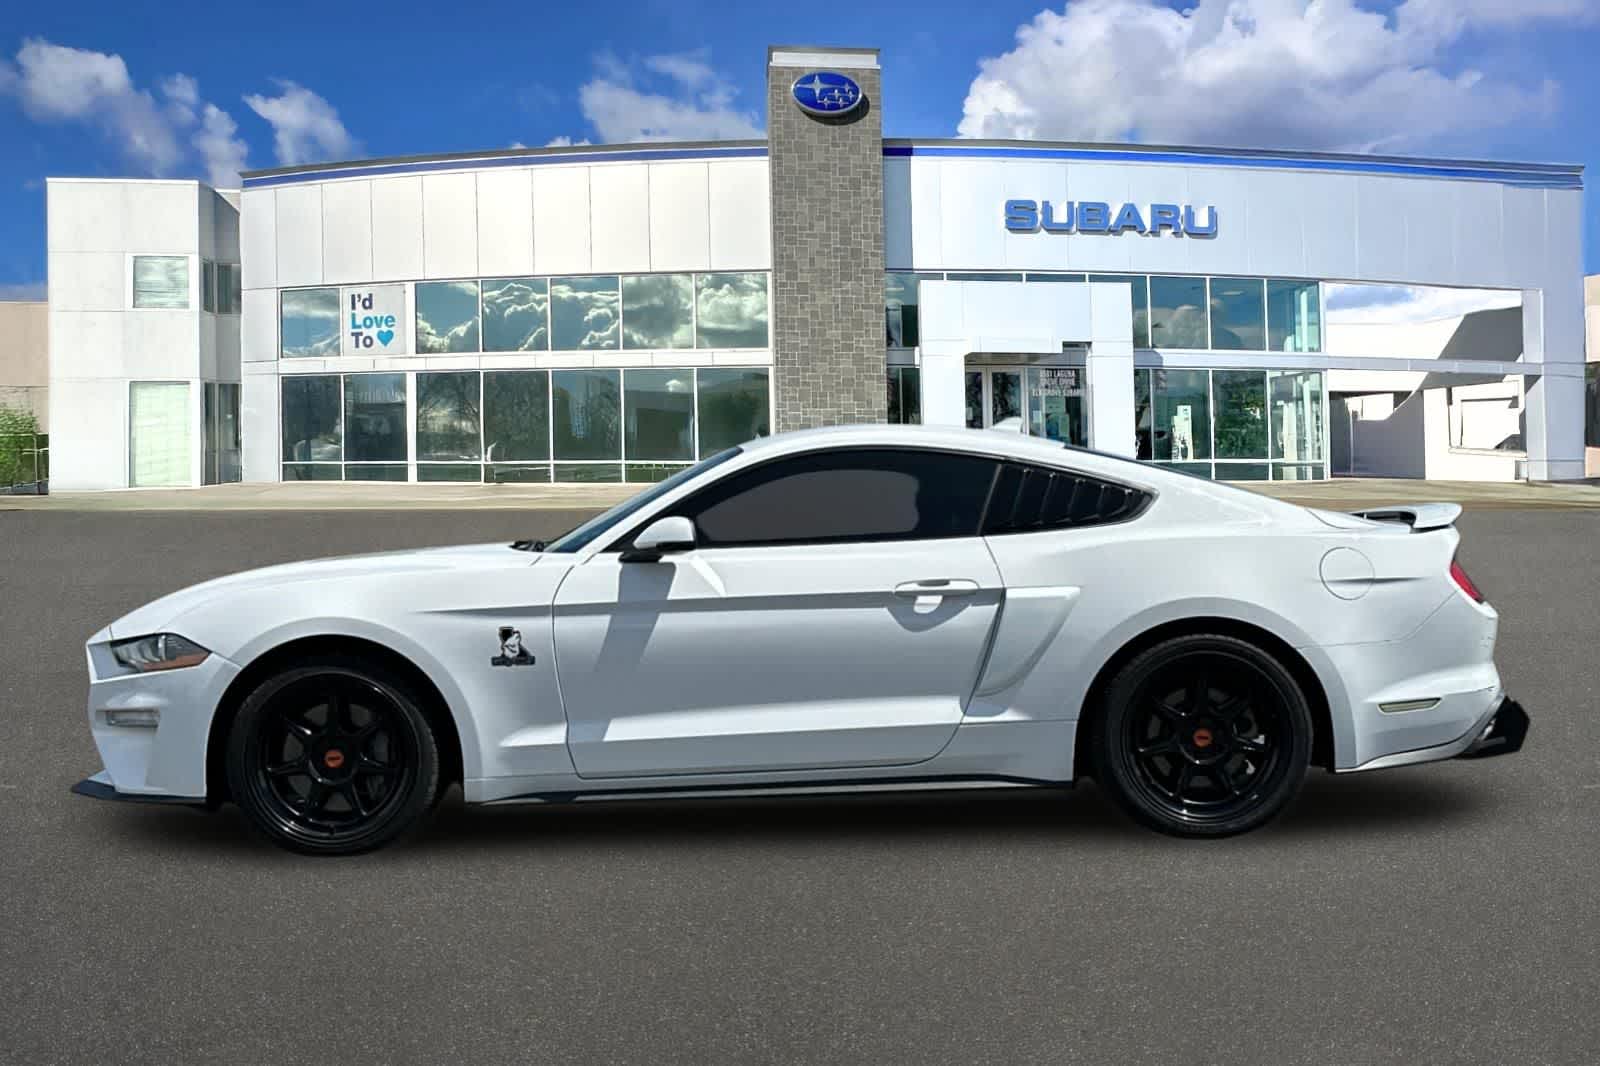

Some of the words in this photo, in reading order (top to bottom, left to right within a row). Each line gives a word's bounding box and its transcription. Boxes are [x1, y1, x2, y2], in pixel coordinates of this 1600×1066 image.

[1005, 199, 1217, 237] SUBARU
[351, 293, 373, 310] I’d
[351, 312, 396, 329] Love
[351, 332, 374, 348] To
